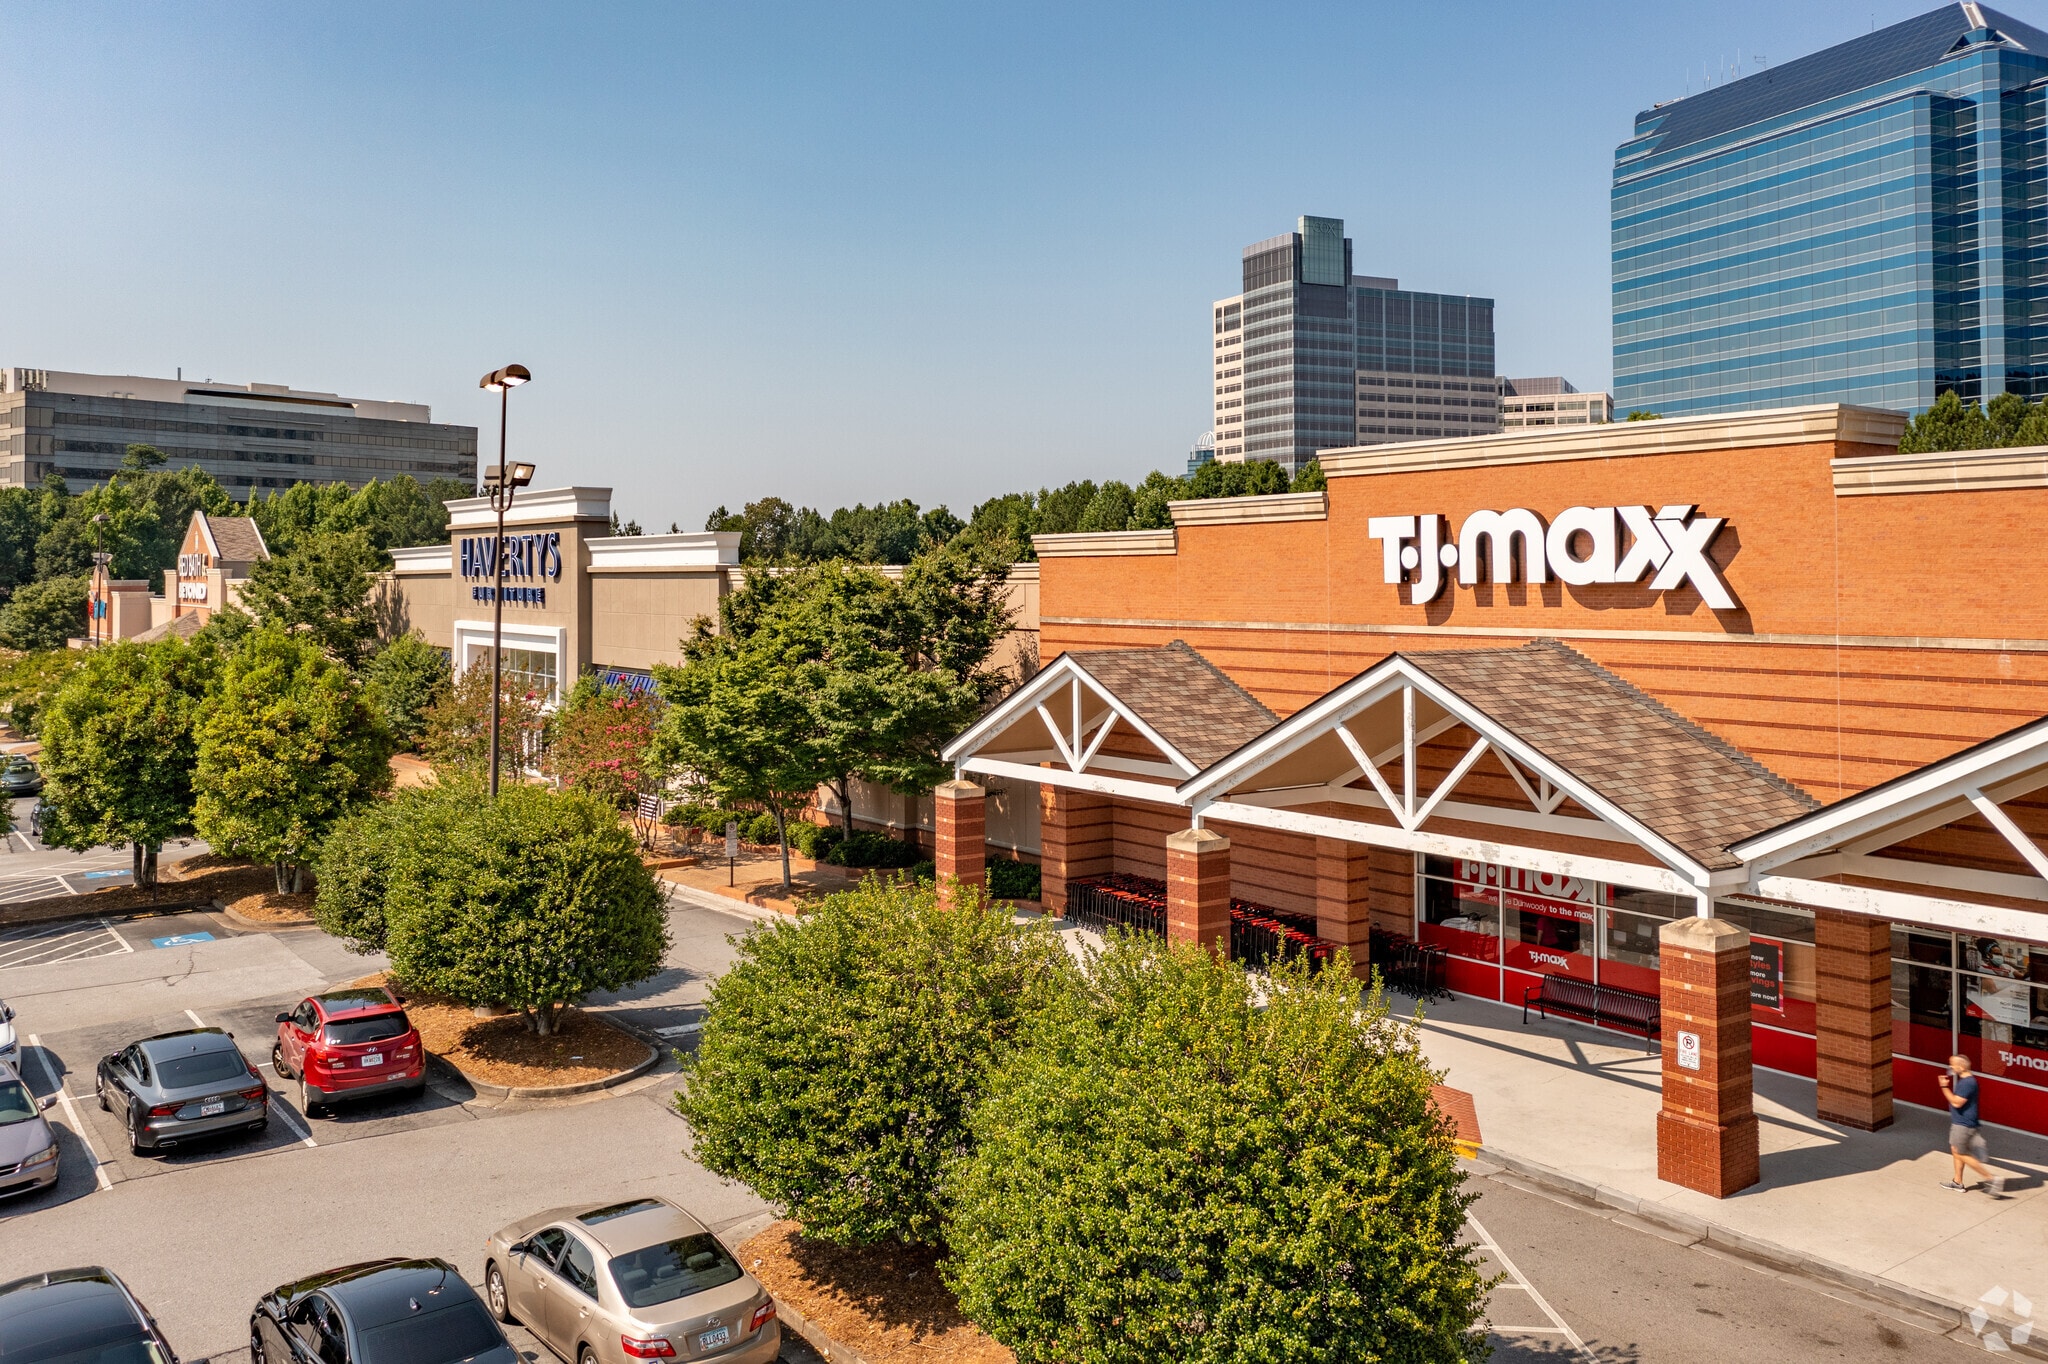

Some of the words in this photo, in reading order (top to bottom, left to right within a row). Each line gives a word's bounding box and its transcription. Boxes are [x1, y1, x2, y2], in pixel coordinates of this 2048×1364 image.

[1513, 899, 1547, 913] Dunwoody
[1549, 905, 1557, 913] to
[1559, 907, 1572, 916] the
[1751, 954, 1764, 962] new
[1750, 959, 1771, 971] tyles
[1750, 970, 1766, 978] more
[1763, 993, 1777, 1001] now!
